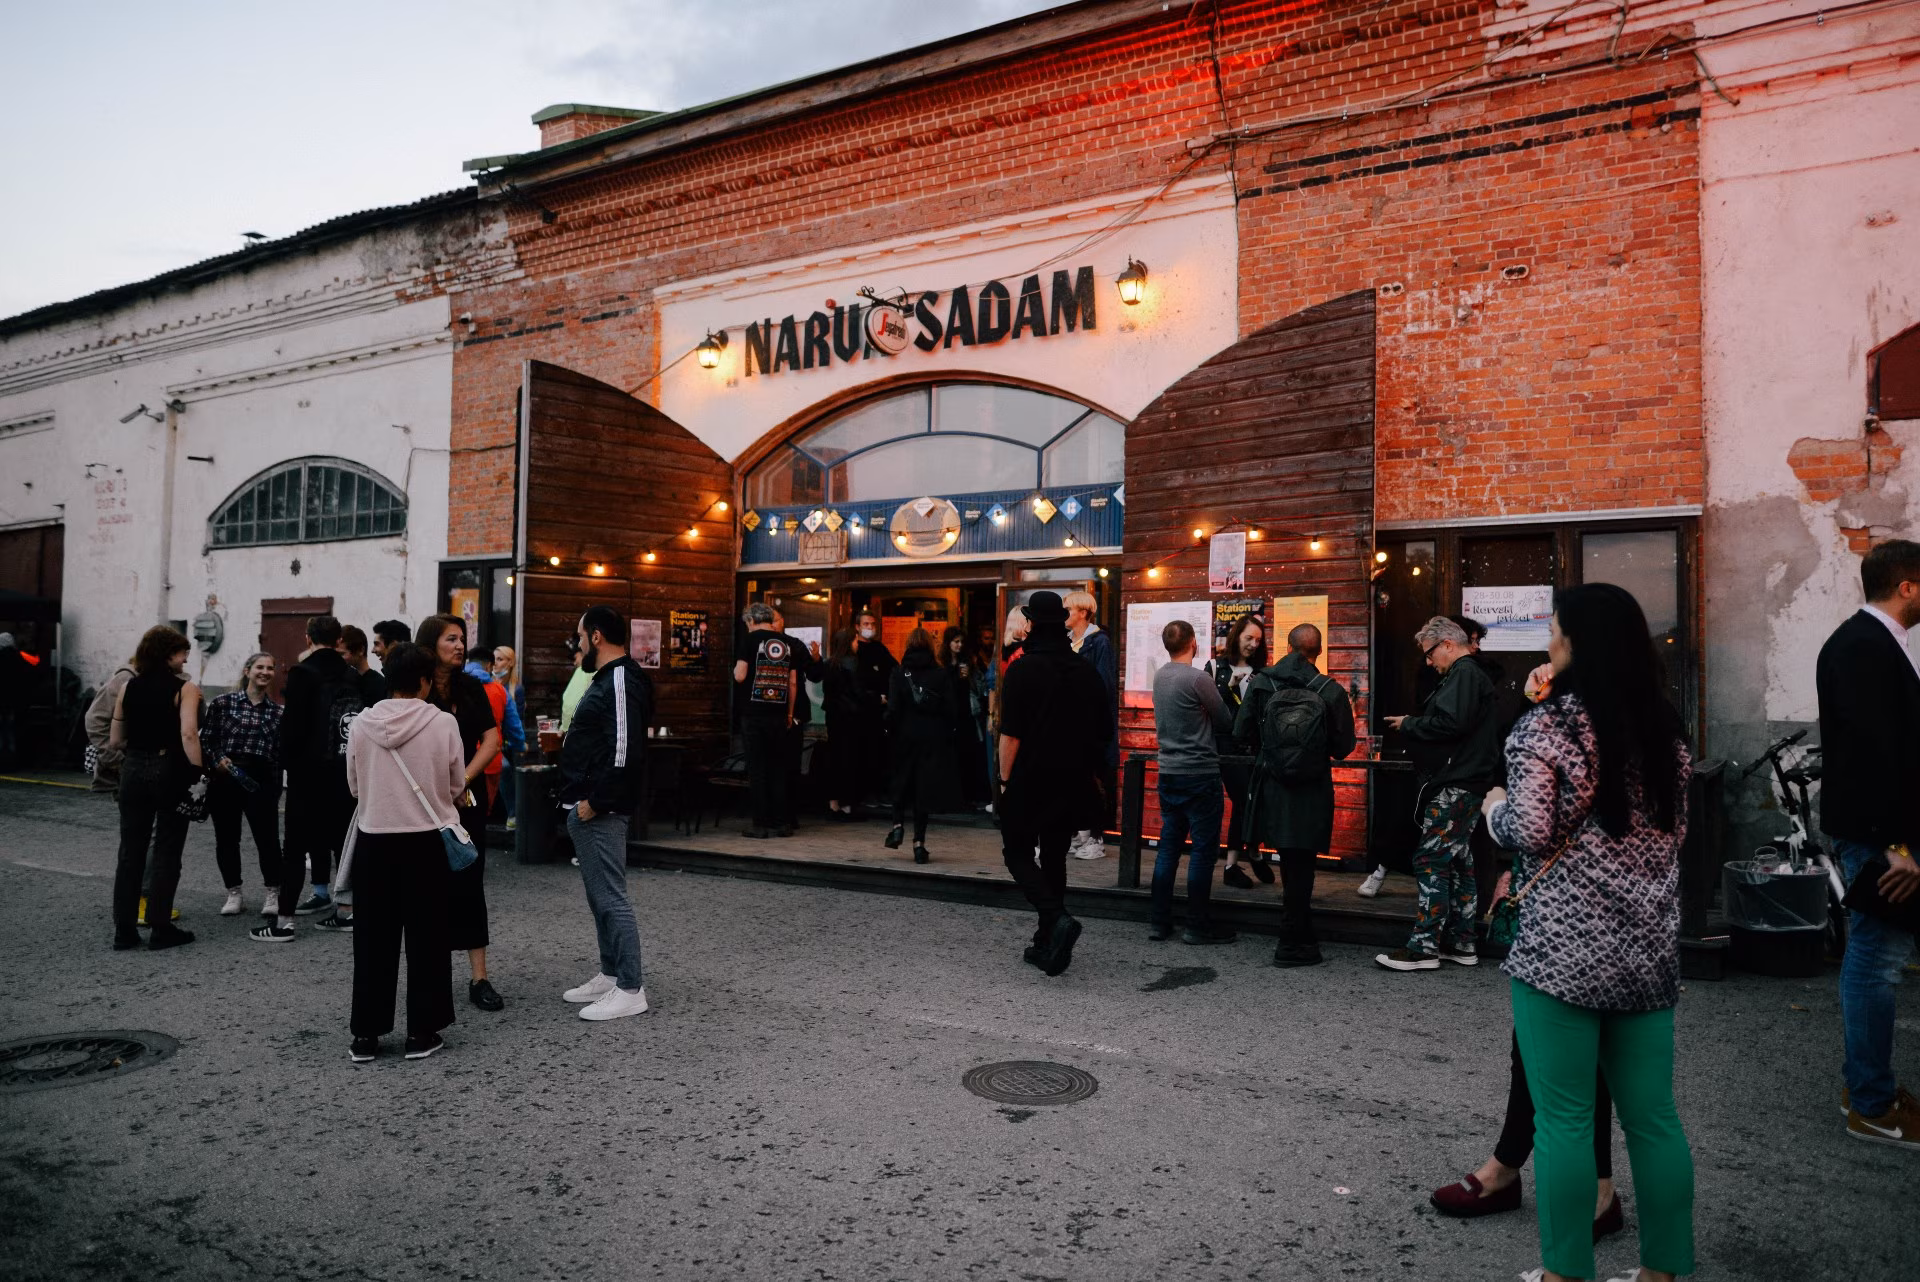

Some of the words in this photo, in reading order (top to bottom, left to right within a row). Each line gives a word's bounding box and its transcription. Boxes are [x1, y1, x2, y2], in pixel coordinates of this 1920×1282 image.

[914, 265, 1097, 352] SADAM
[1473, 591, 1514, 600] 28-30.08
[1131, 608, 1152, 616] Station
[1216, 604, 1251, 613] Station
[671, 610, 699, 620] Station
[671, 618, 695, 627] Narva
